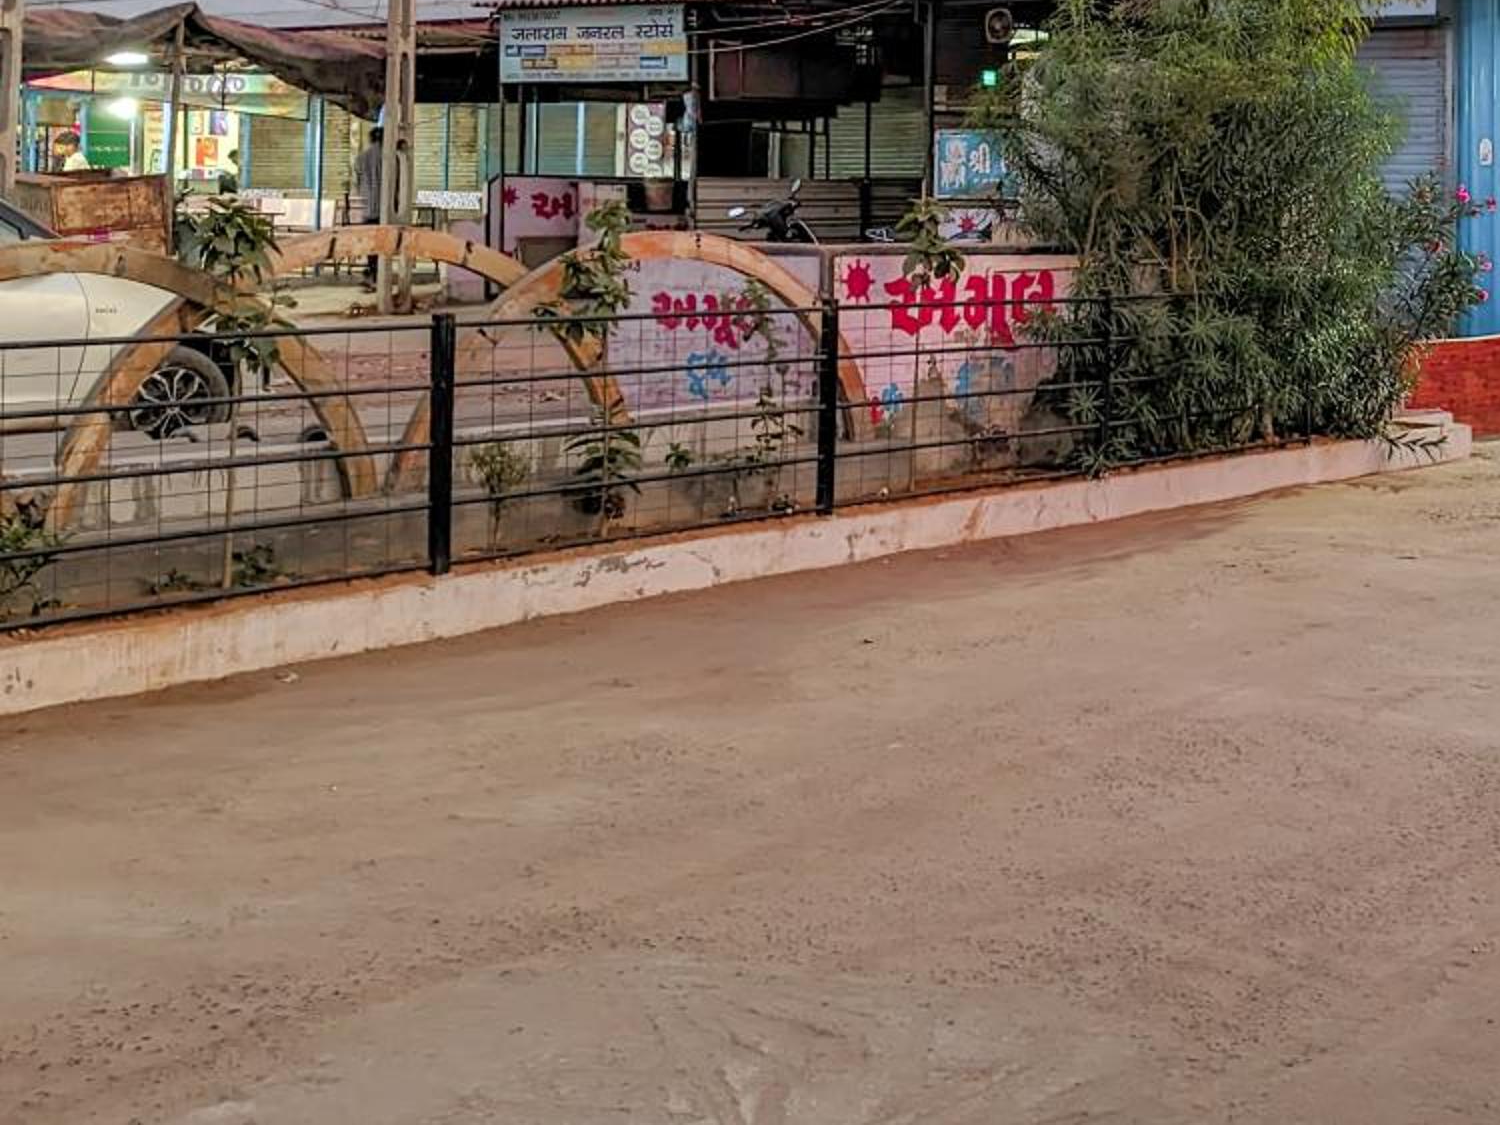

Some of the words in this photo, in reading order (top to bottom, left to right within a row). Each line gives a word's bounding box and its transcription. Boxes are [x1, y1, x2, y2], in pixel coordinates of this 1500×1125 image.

[511, 26, 567, 41] जलाराम
[576, 25, 625, 40] जनरल
[634, 17, 674, 39] स्टोर्स
